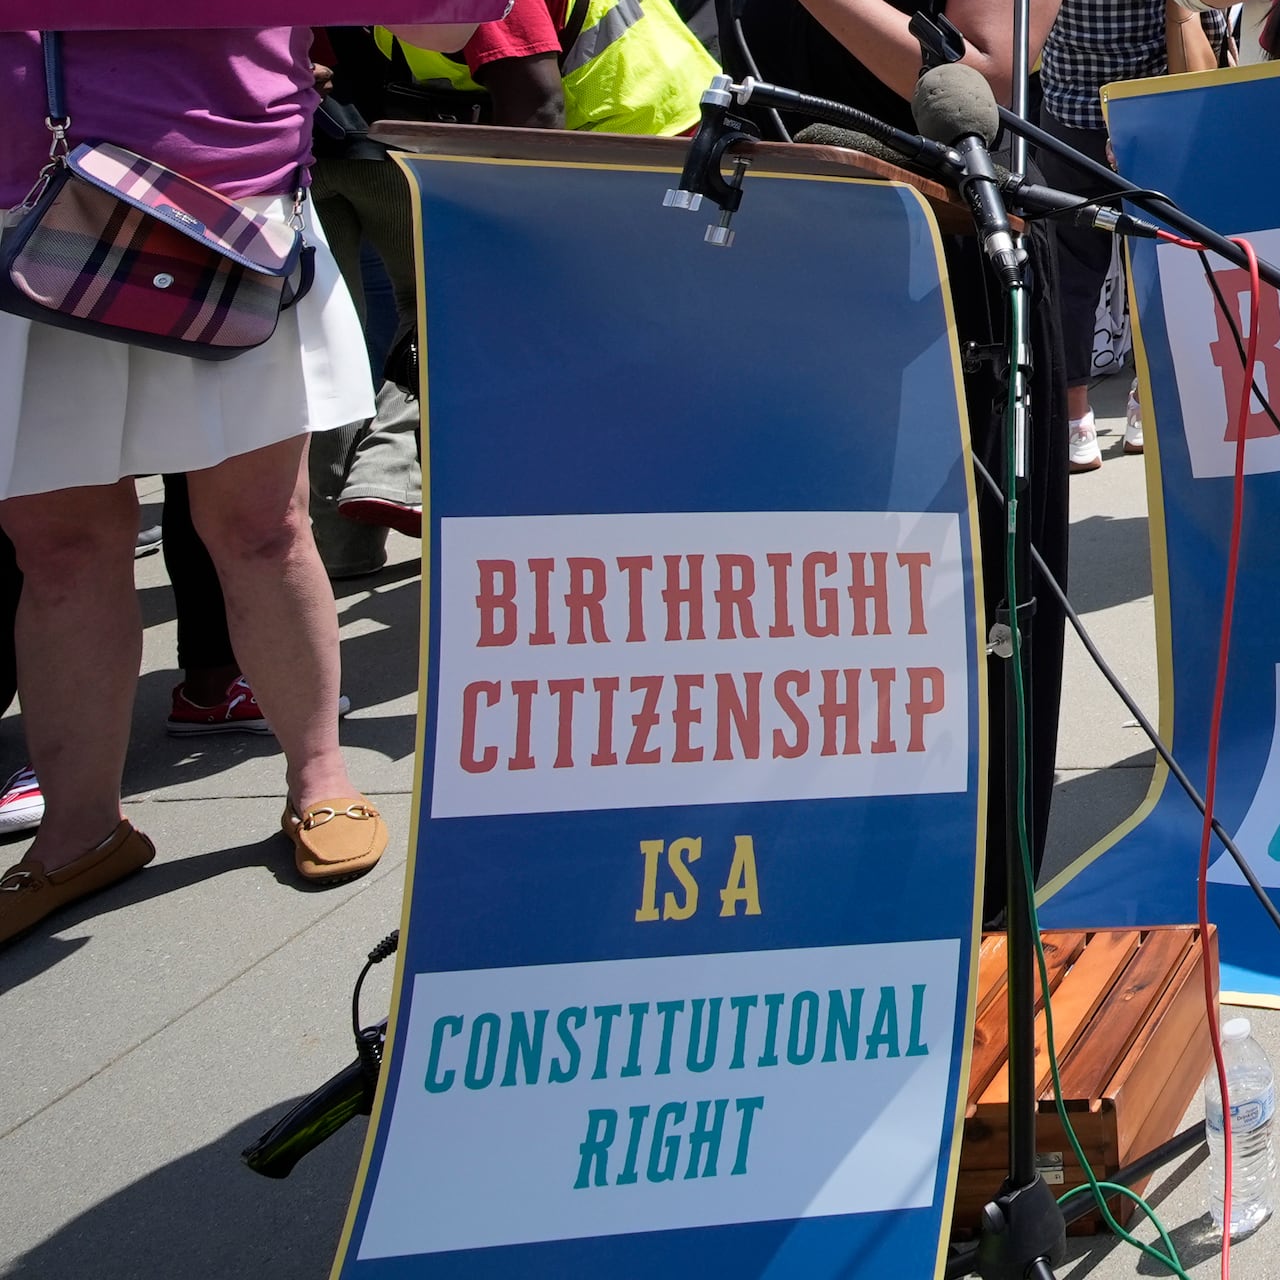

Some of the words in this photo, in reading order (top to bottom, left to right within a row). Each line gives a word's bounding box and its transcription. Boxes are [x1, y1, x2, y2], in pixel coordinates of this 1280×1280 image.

[474, 549, 934, 649] BIRTHRIGHT
[459, 665, 947, 774] CITIZENSHIP
[634, 836, 700, 923] IS
[720, 834, 763, 918] A
[423, 983, 931, 1095] CONSTITUTIONAL
[572, 1095, 766, 1191] RIGHT
